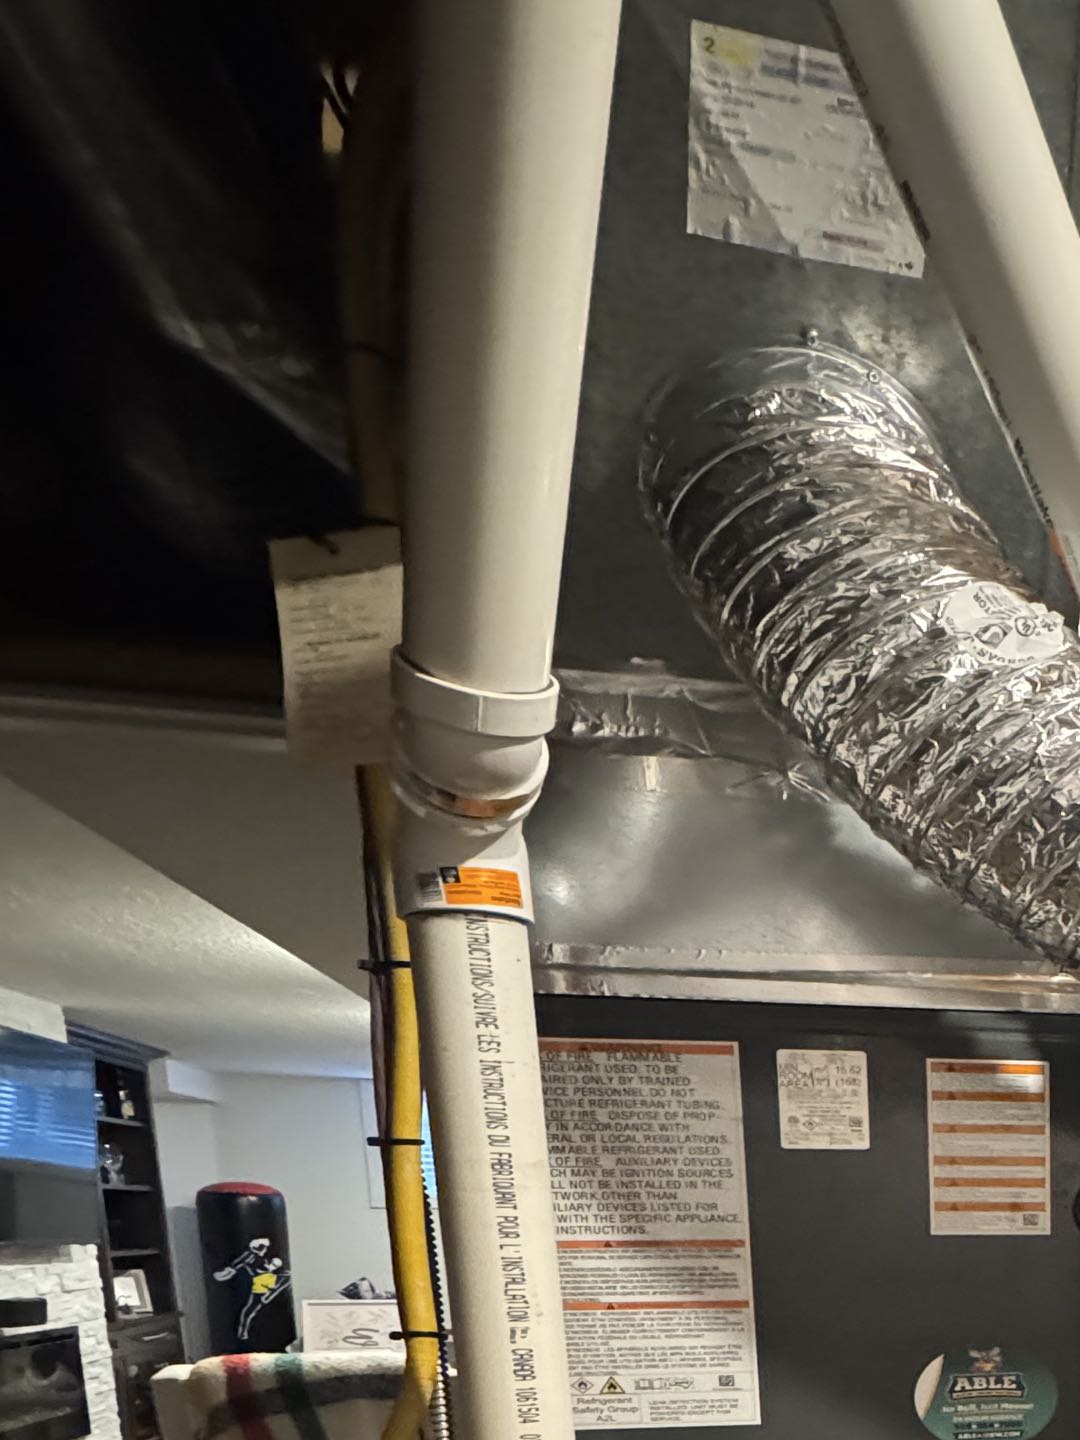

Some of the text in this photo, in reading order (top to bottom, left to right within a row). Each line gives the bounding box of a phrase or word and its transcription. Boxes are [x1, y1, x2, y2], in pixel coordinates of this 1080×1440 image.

[477, 1033, 502, 1053] LES
[607, 1053, 682, 1063] FLAMMABLE
[646, 1064, 660, 1074] TO
[664, 1065, 679, 1074] BE
[582, 1076, 614, 1086] ONLY
[618, 1076, 633, 1086] BY
[639, 1077, 691, 1086] TRAINED
[480, 1059, 509, 1130] INSTRUCTIONS
[650, 1088, 667, 1097] DO
[670, 1089, 695, 1097] NOT
[588, 1100, 674, 1110] REFRIGERANT
[608, 1112, 659, 1121] DISPOSE
[664, 1112, 679, 1121] OF
[555, 1122, 690, 1132] IN ACCORDANCE WITH
[487, 1134, 511, 1147] DU
[580, 1134, 596, 1144] OR
[601, 1135, 640, 1144] LOCAL
[601, 1146, 684, 1156] REFRIGERANT
[556, 1157, 571, 1166] OF
[616, 1157, 679, 1167] AUXILIARY
[684, 1158, 733, 1167] DEVICES
[550, 1169, 734, 1179] CH MAY BE IGNITION SOURCES
[490, 1152, 518, 1210] FABRIQUANT
[569, 1180, 593, 1190] NOT
[599, 1180, 613, 1190] BE
[616, 1180, 681, 1190] INSTALLED
[685, 1181, 698, 1190] IN
[701, 1181, 724, 1190] THE
[602, 1191, 641, 1201] OTHER
[646, 1192, 678, 1201] THAN
[597, 1203, 647, 1212] DEVICES
[651, 1203, 691, 1212] LISTED
[695, 1203, 719, 1212] FOR
[556, 1214, 589, 1224] WITH
[593, 1214, 616, 1224] THE
[619, 1214, 671, 1223] SPECIFIC
[496, 1215, 520, 1240] POUR
[511, 1348, 537, 1381] CANADA
[954, 1375, 1018, 1391] ABLE
[516, 1387, 540, 1424] 1061504
[577, 1397, 633, 1406] Refrigerant
[572, 1405, 639, 1415] Safety Group
